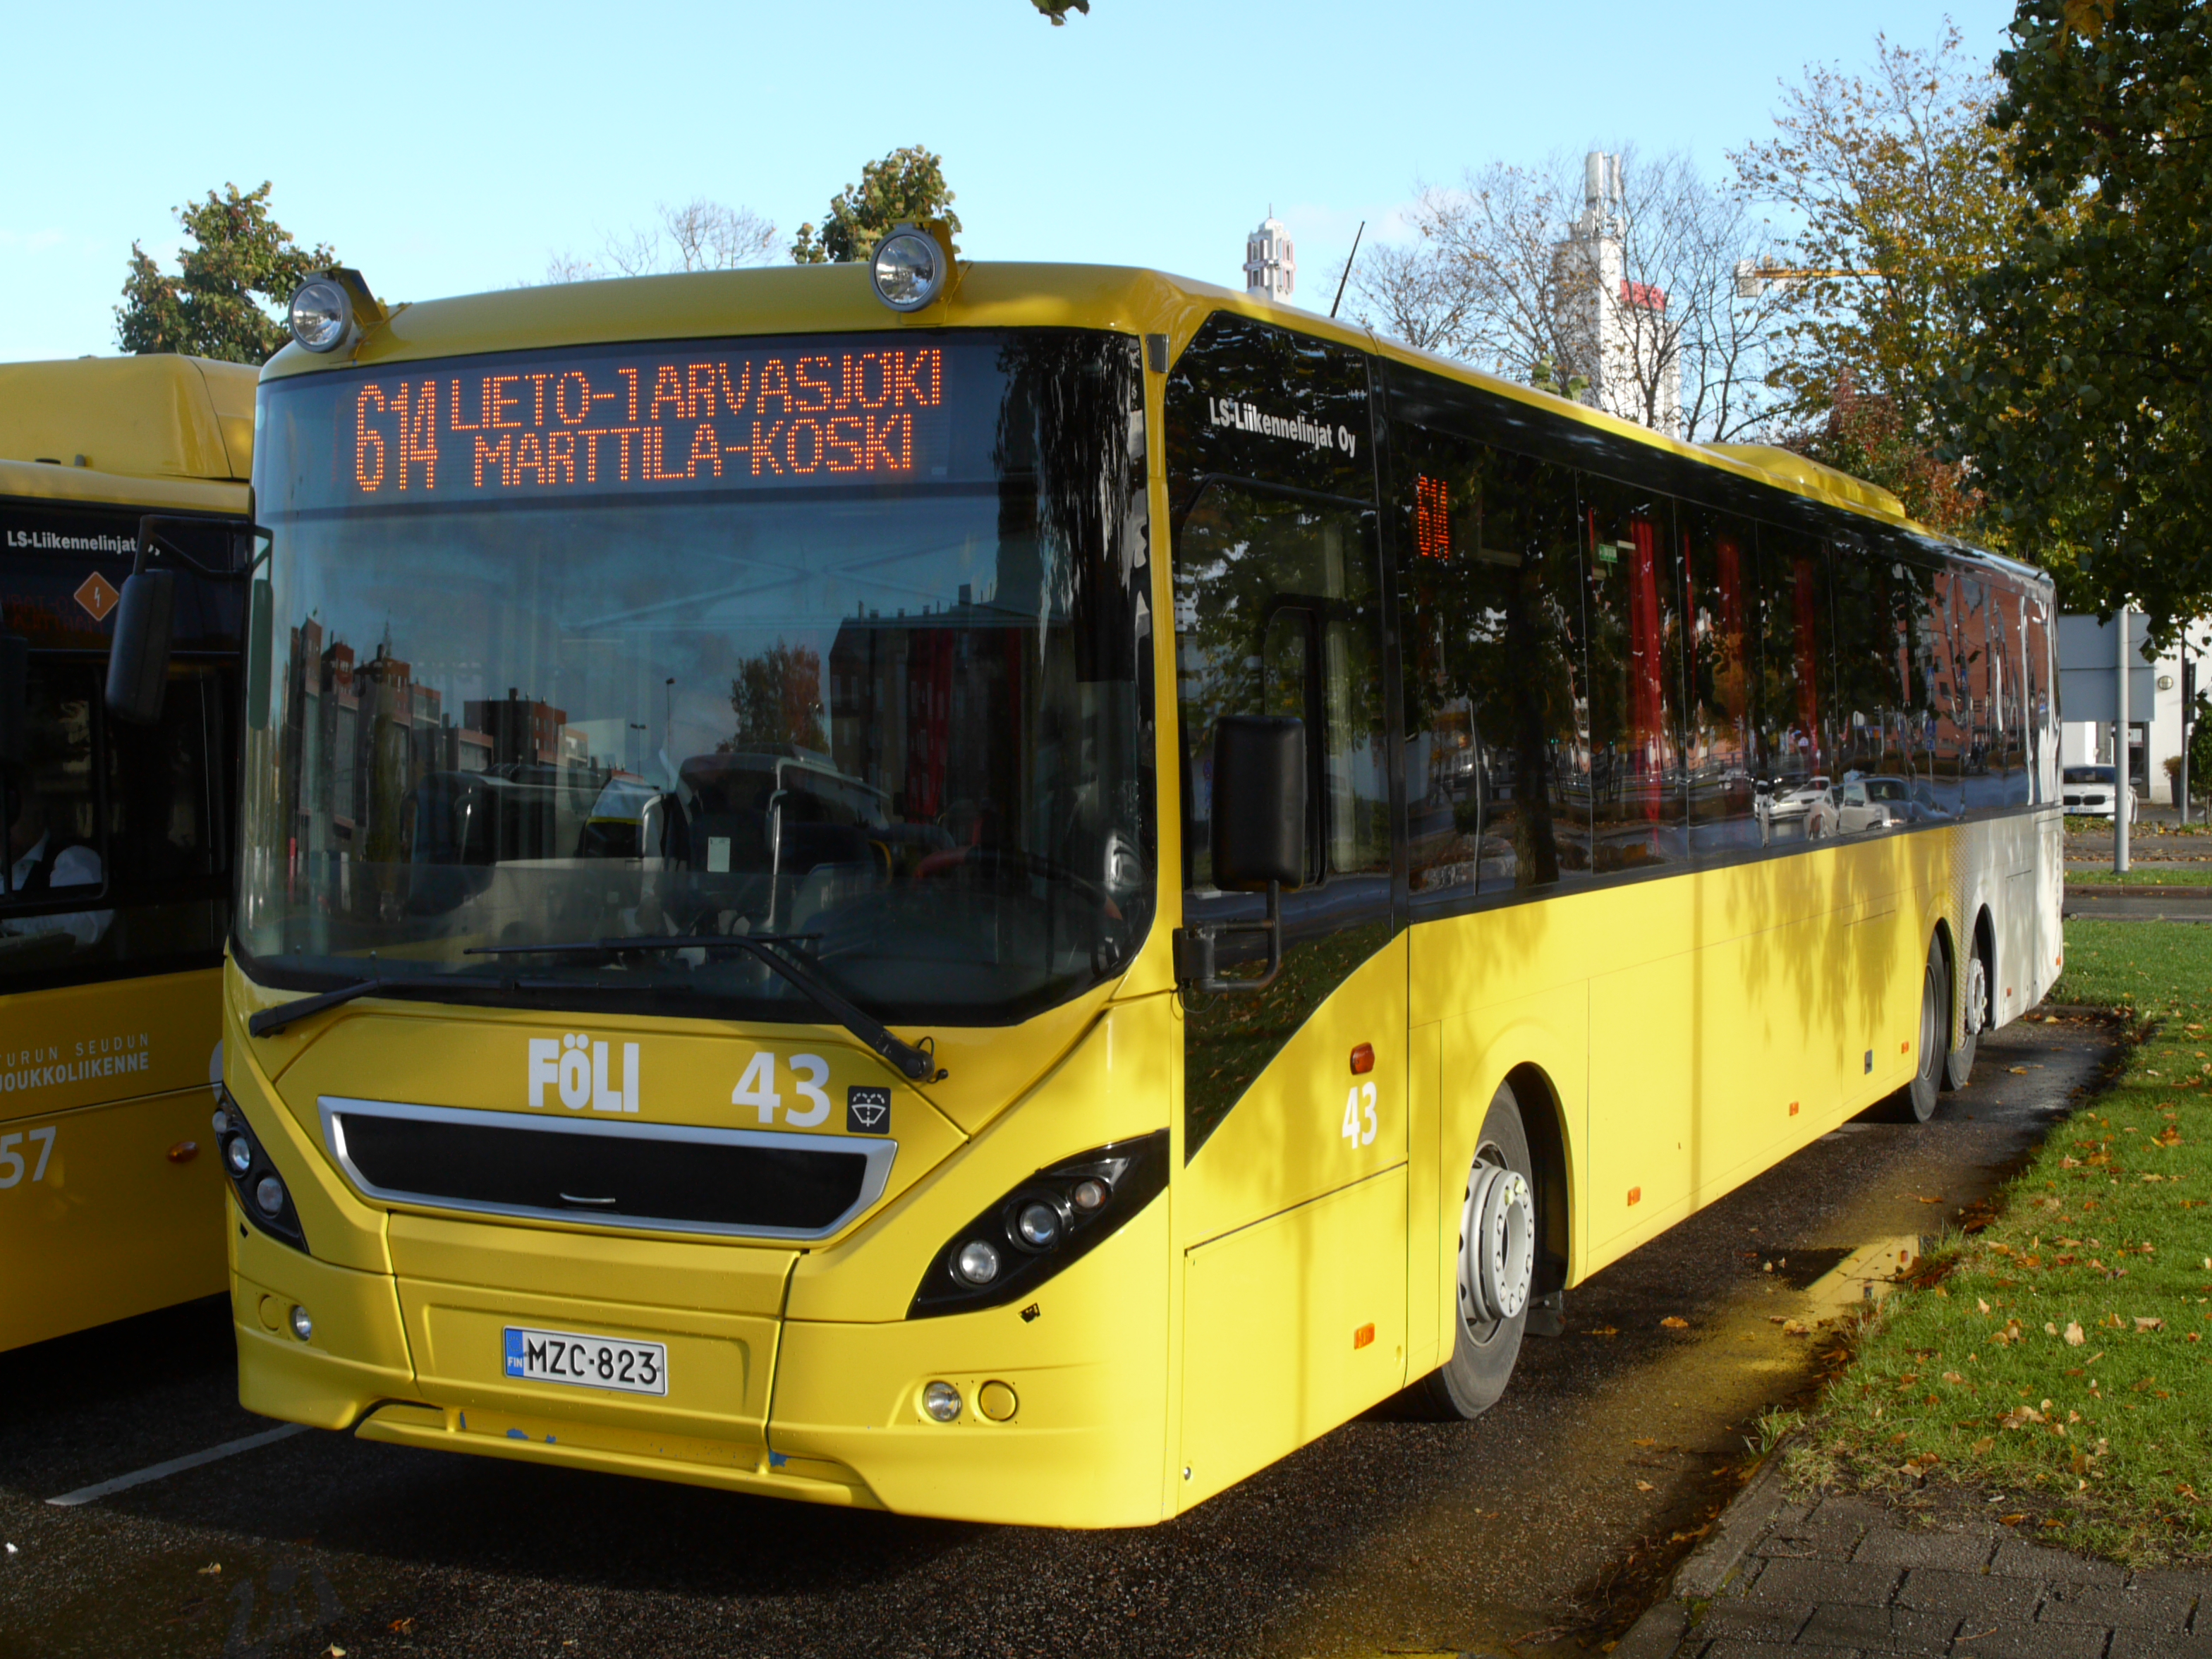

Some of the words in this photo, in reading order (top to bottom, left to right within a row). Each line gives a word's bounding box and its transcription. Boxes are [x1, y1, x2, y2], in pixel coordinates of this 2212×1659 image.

[356, 381, 438, 492] 614
[474, 413, 911, 487] MARTTILA-KOSKI
[1209, 397, 1332, 450] LS-Liikennelinjat
[1338, 425, 1356, 458] Oy
[6, 530, 136, 555] LS-Liikennelinjat
[0, 1046, 58, 1067] URUN
[75, 1032, 150, 1057] SEUDUN
[528, 1033, 639, 1112] FÖLI
[731, 1052, 831, 1128] 43
[1342, 1081, 1378, 1150] 43
[507, 1356, 523, 1368] FIN
[528, 1337, 657, 1385] MZC-823
